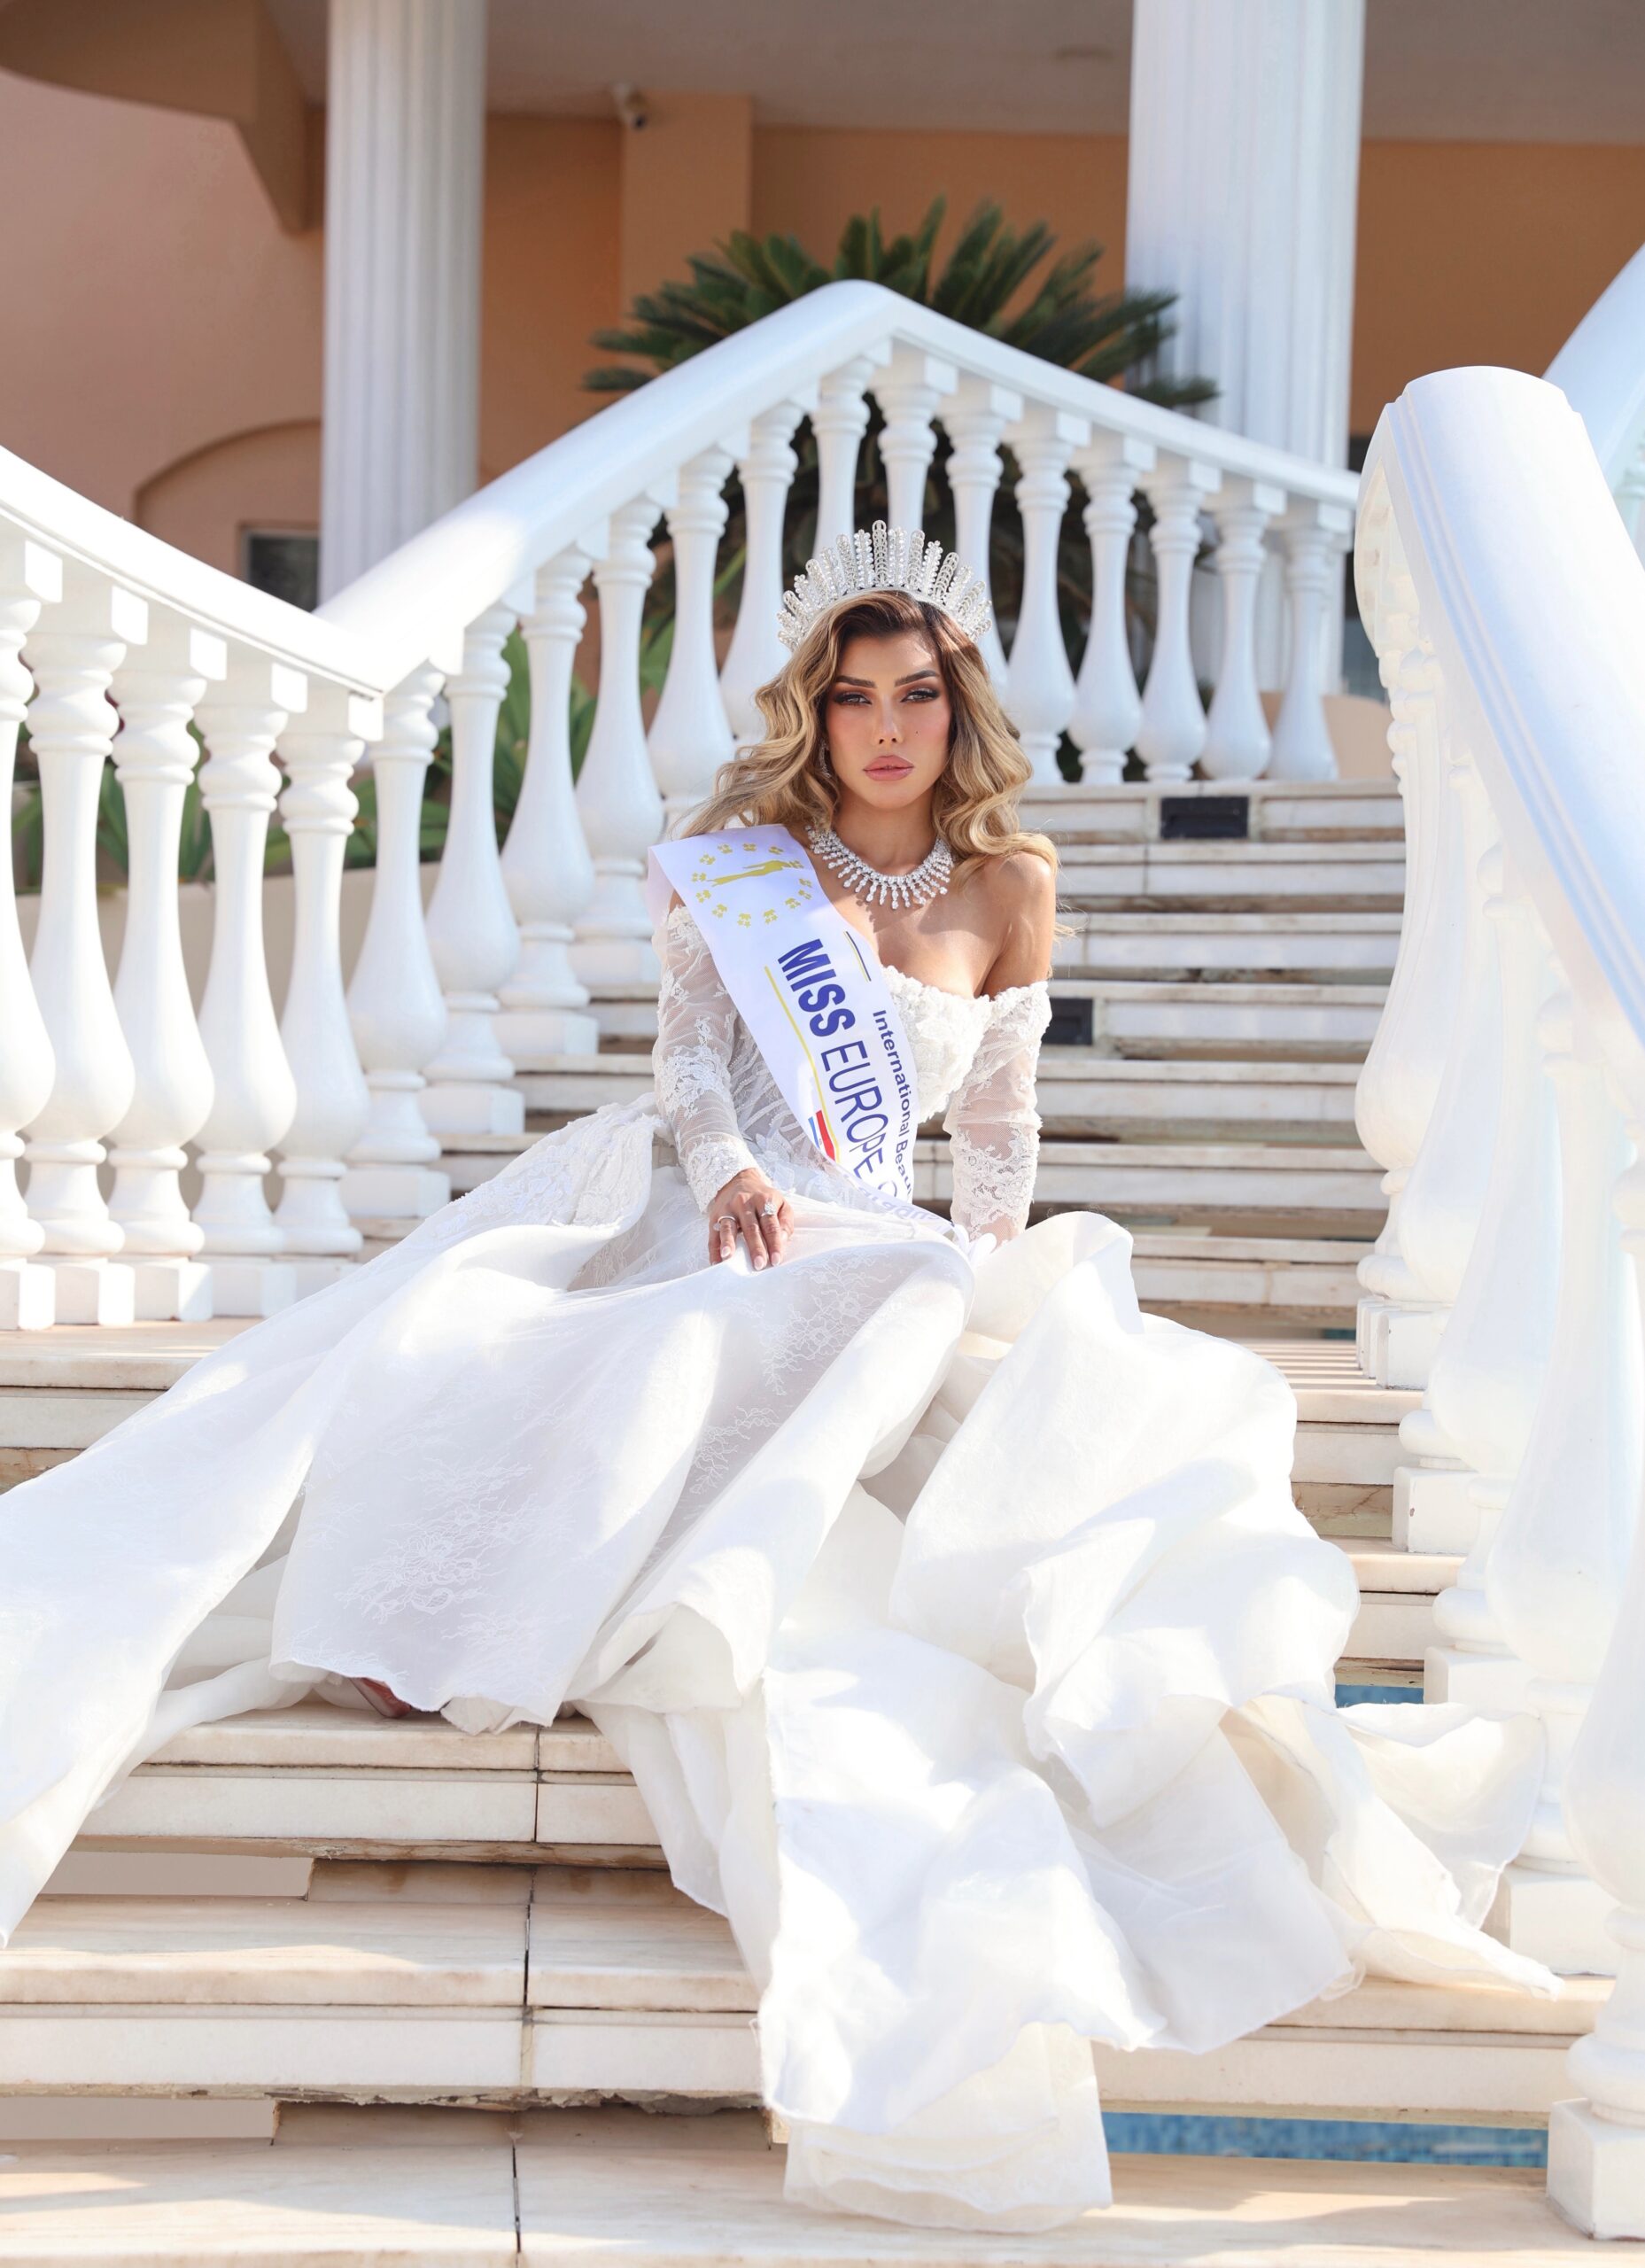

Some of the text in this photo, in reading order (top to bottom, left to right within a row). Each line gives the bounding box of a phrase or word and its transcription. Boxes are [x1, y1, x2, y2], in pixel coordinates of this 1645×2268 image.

[778, 938, 888, 1179] MISS EUROPE
[873, 1010, 912, 1137] International
